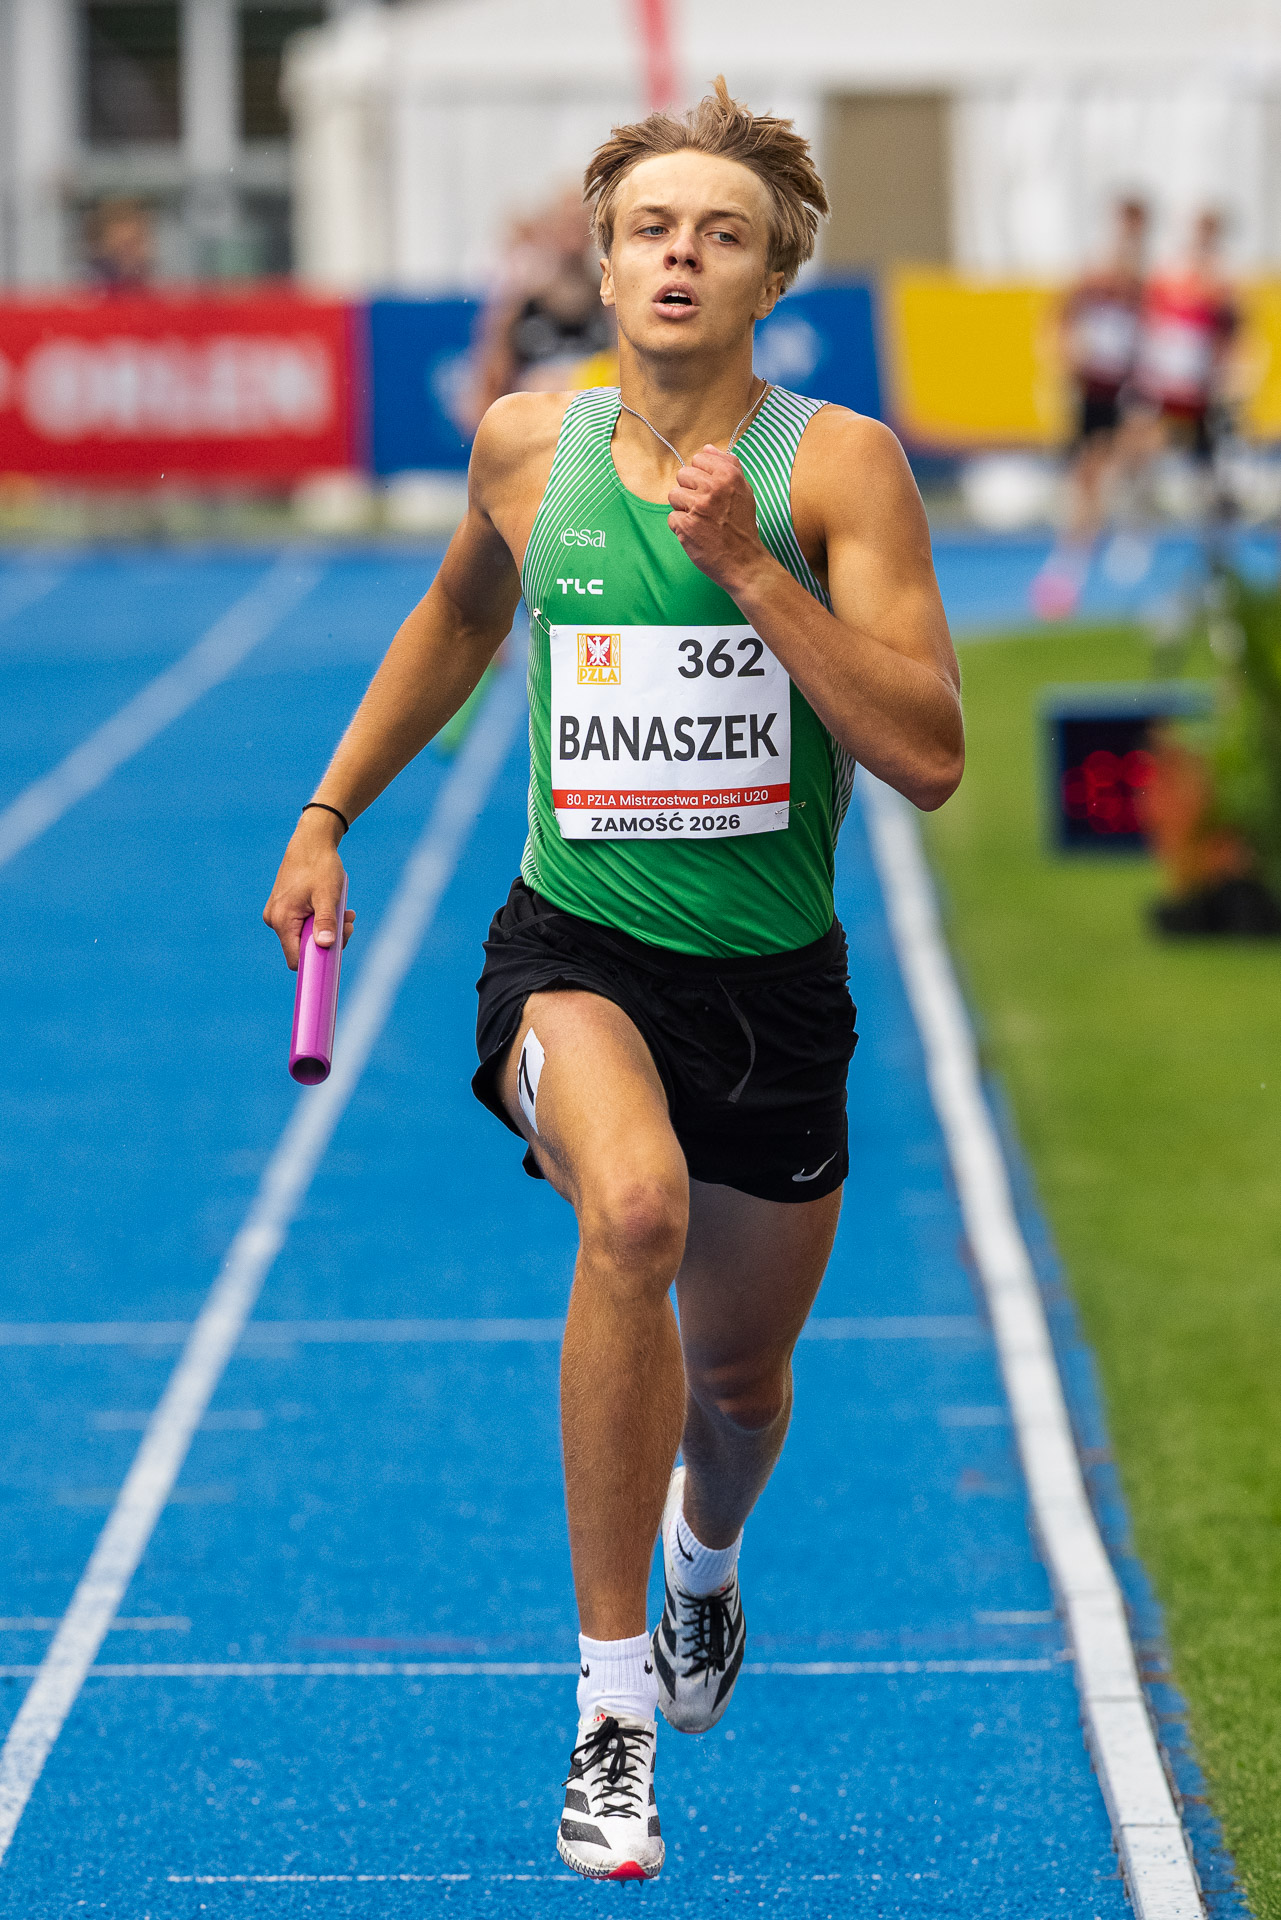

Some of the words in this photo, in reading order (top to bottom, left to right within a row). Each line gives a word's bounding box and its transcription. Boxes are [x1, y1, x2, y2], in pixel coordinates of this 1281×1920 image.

[560, 527, 606, 548] esa
[556, 578, 604, 595] TLC
[677, 637, 766, 679] 362
[579, 666, 618, 683] PZLA
[559, 712, 779, 762] BANASZEK
[566, 793, 584, 806] 80.
[587, 794, 617, 806] PZLA
[619, 794, 699, 806] Mistrzostwa
[702, 791, 741, 806] Polski
[744, 789, 769, 803] U20
[591, 811, 684, 832] ZAMOŚĆ
[689, 814, 741, 832] 2026
